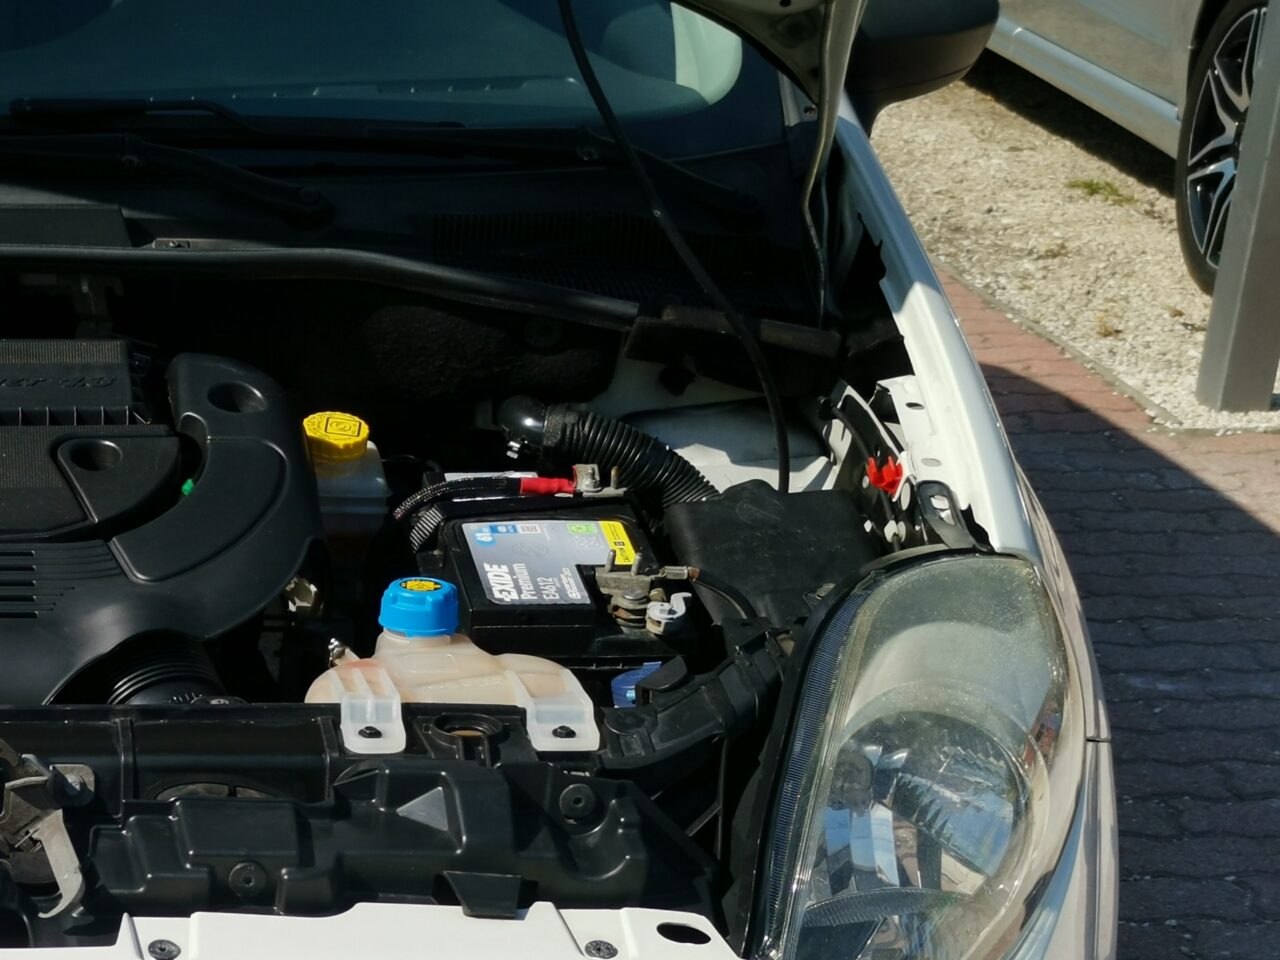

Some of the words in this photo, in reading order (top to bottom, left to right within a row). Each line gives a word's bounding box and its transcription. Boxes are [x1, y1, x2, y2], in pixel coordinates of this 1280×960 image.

[483, 562, 520, 602] EXIDE
[512, 563, 538, 600] Premium
[536, 576, 560, 601] EA612
